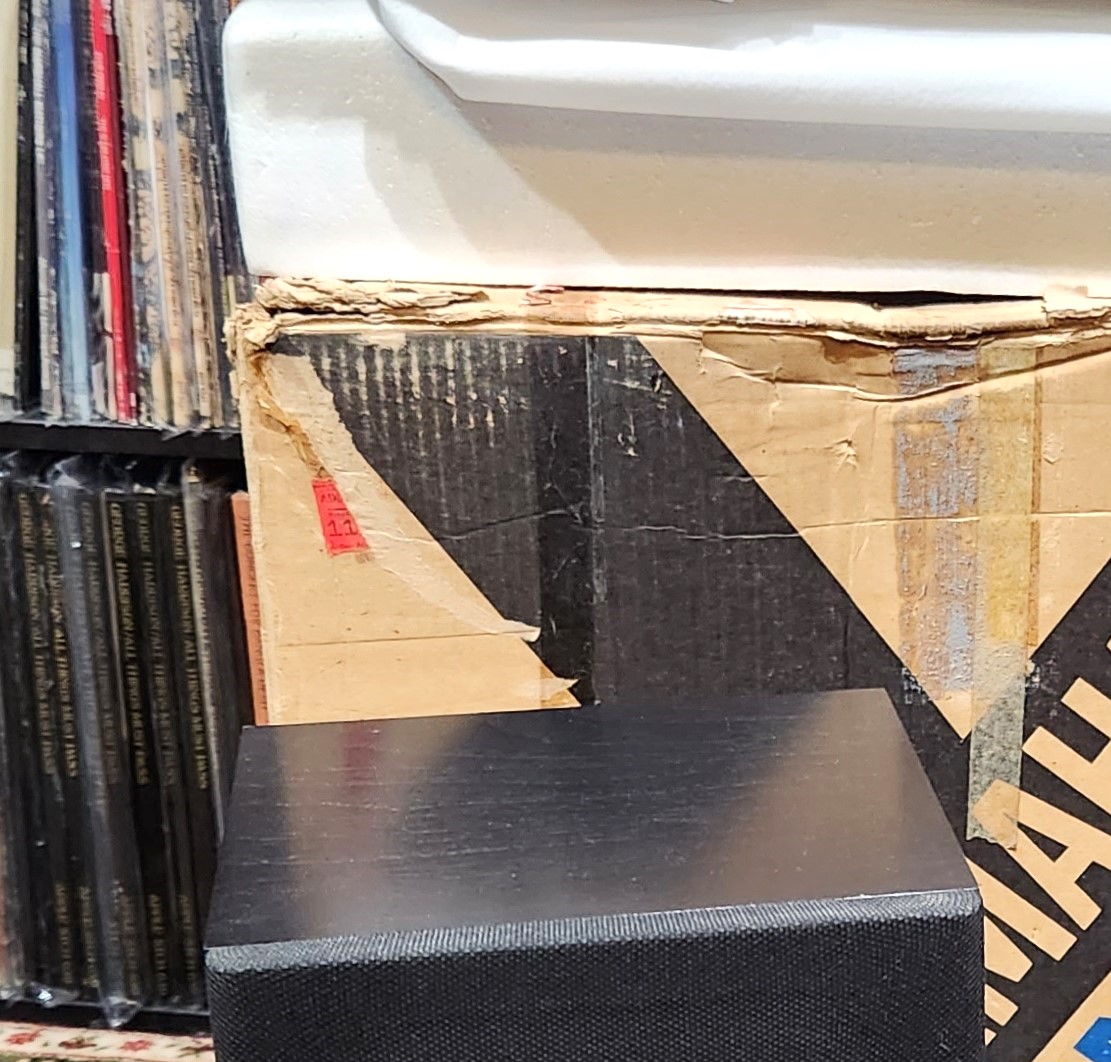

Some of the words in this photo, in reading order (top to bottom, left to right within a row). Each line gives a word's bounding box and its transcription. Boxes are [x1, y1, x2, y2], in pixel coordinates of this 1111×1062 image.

[108, 501, 125, 554] GEORGE
[126, 665, 142, 710] THINGS
[130, 711, 146, 746] MUST
[134, 750, 150, 785] PASS
